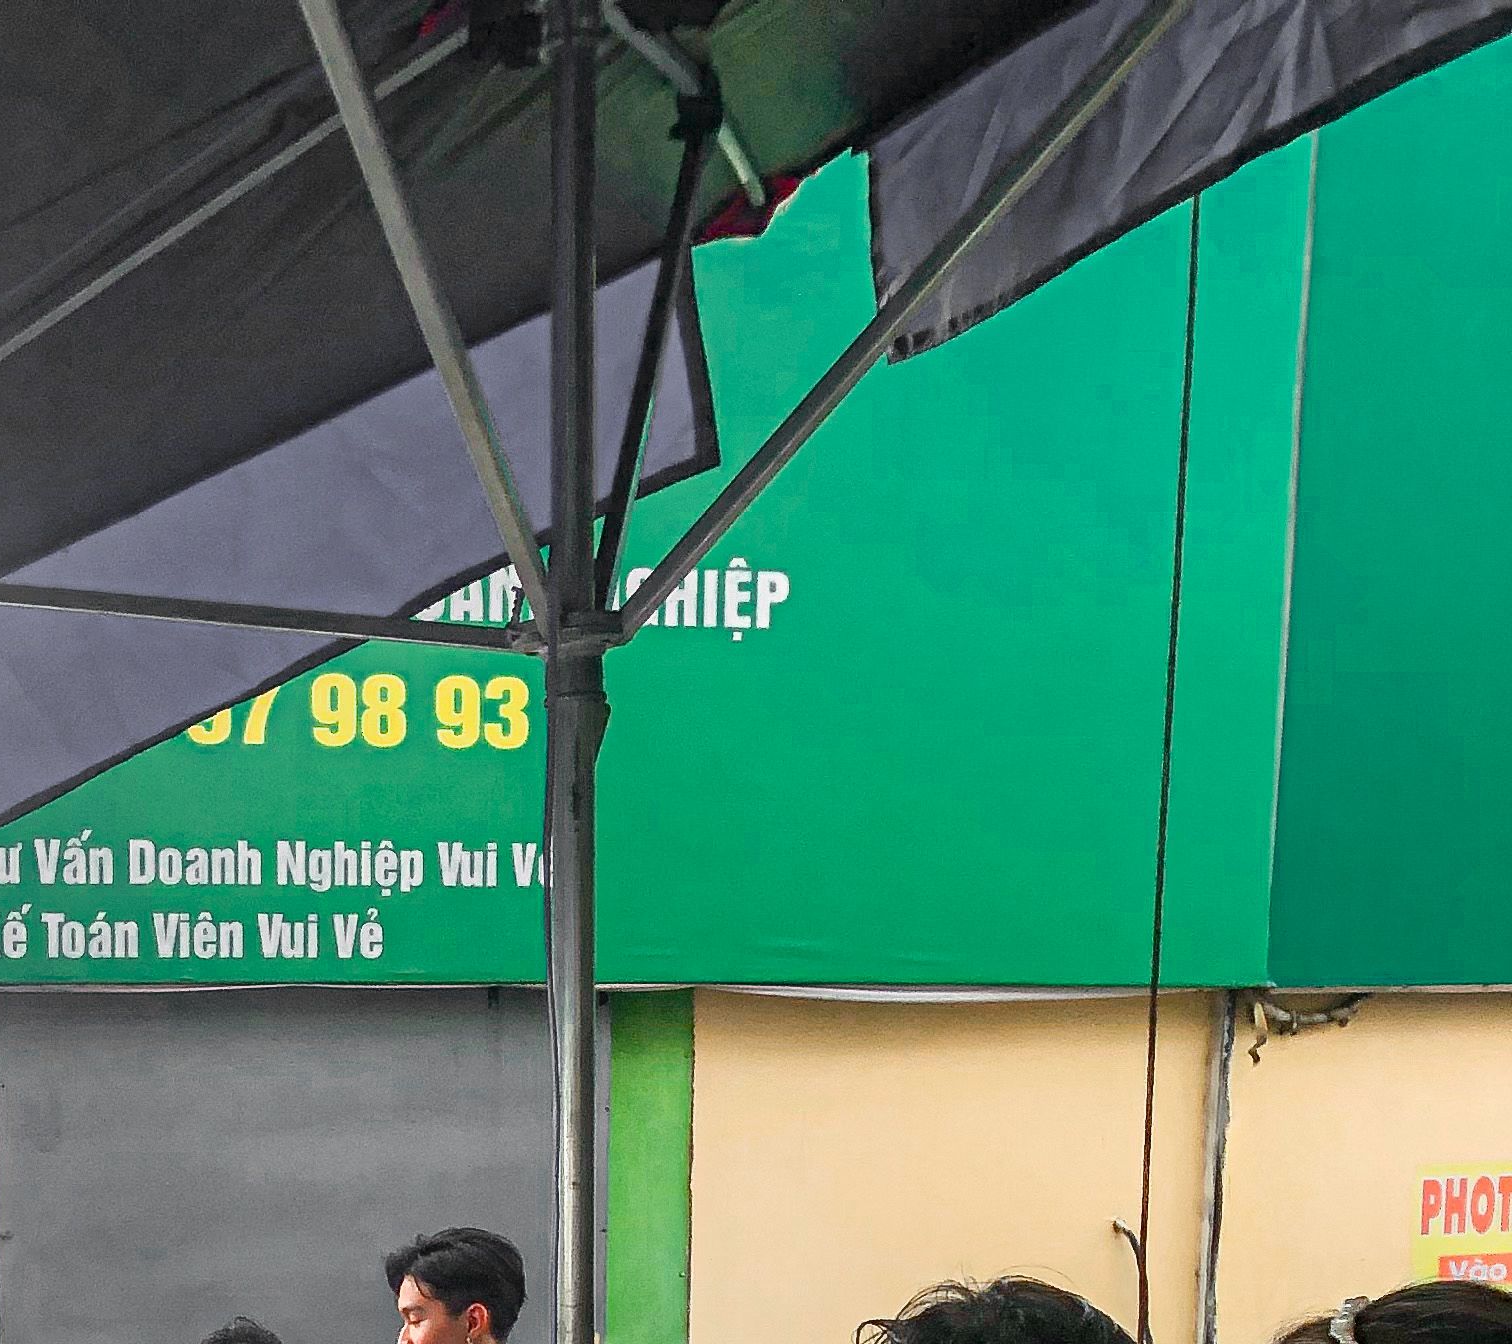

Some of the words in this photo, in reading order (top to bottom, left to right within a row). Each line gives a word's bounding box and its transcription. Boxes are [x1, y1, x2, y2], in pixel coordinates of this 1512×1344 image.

[312, 673, 406, 746] 98
[436, 675, 529, 749] 93
[34, 829, 114, 885] Vấn
[129, 839, 262, 885] Doanh
[277, 840, 424, 896] Nghiệp
[437, 842, 498, 887] Vui
[41, 911, 138, 958] Toán
[153, 911, 244, 958] Viên
[257, 914, 319, 958] Vui
[333, 908, 384, 959] Vẻ
